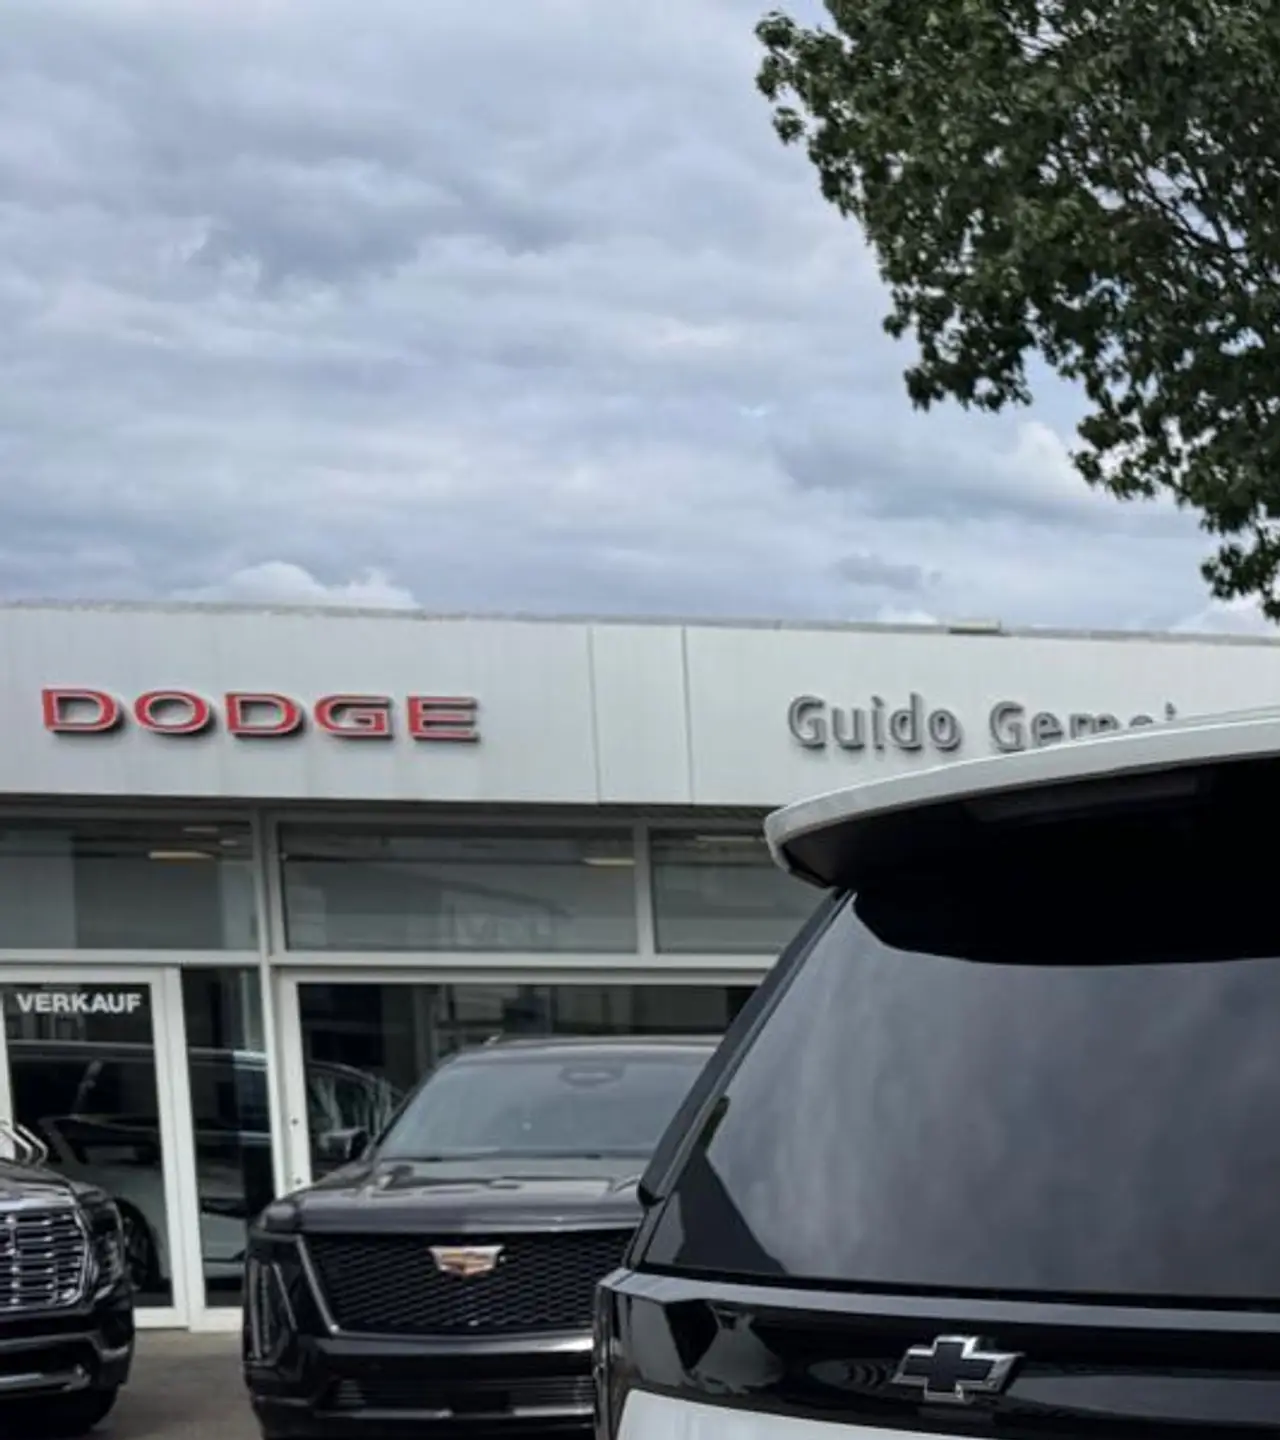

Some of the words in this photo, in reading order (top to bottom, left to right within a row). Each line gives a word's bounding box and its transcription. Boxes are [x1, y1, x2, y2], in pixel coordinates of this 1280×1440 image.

[42, 688, 481, 742] DODGE
[788, 693, 964, 752] Guido
[15, 992, 142, 1013] VERKAUF
